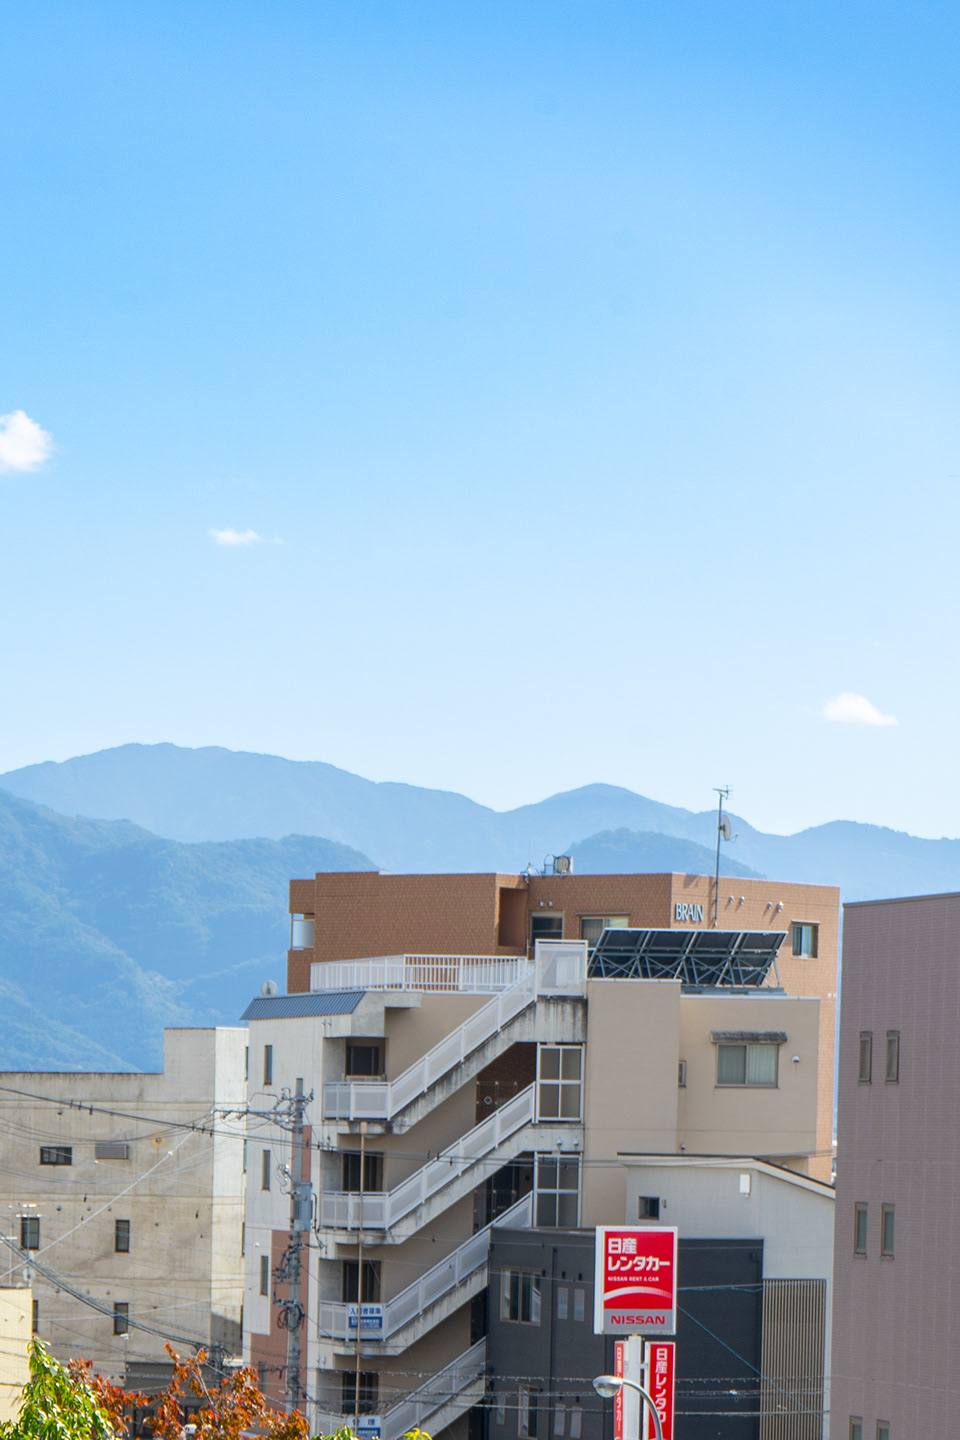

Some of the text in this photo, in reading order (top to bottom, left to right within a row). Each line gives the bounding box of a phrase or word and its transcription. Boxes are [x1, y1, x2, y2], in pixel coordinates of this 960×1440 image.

[675, 903, 704, 922] BRAIN
[607, 1237, 637, 1254] 日産
[607, 1255, 670, 1272] レンタカー
[610, 1315, 665, 1324] NISSAN
[655, 1348, 668, 1423] 日産レンタカ
